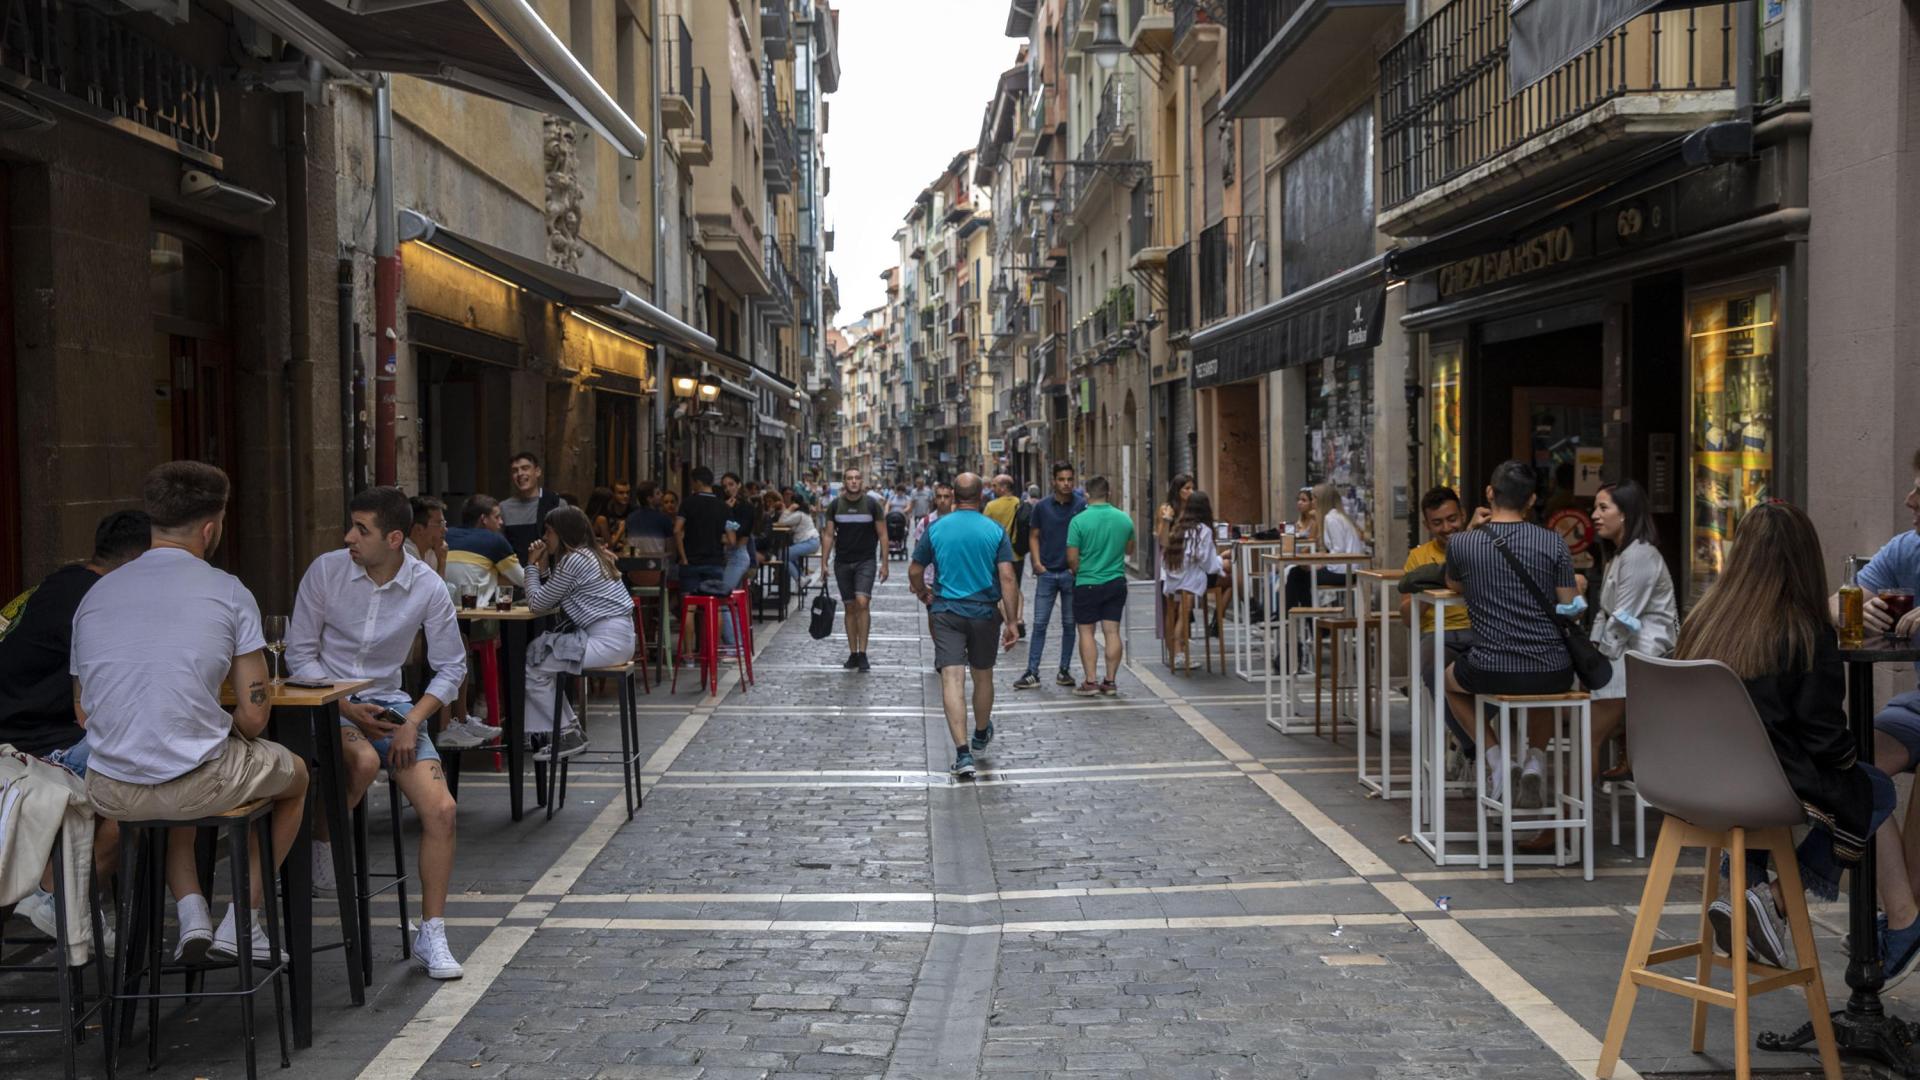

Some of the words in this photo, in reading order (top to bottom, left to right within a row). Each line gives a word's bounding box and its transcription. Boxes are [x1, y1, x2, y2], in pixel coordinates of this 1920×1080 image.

[1617, 207, 1643, 236] 69
[1439, 256, 1482, 297] CHEZ
[1483, 226, 1575, 284] EVARISTO
